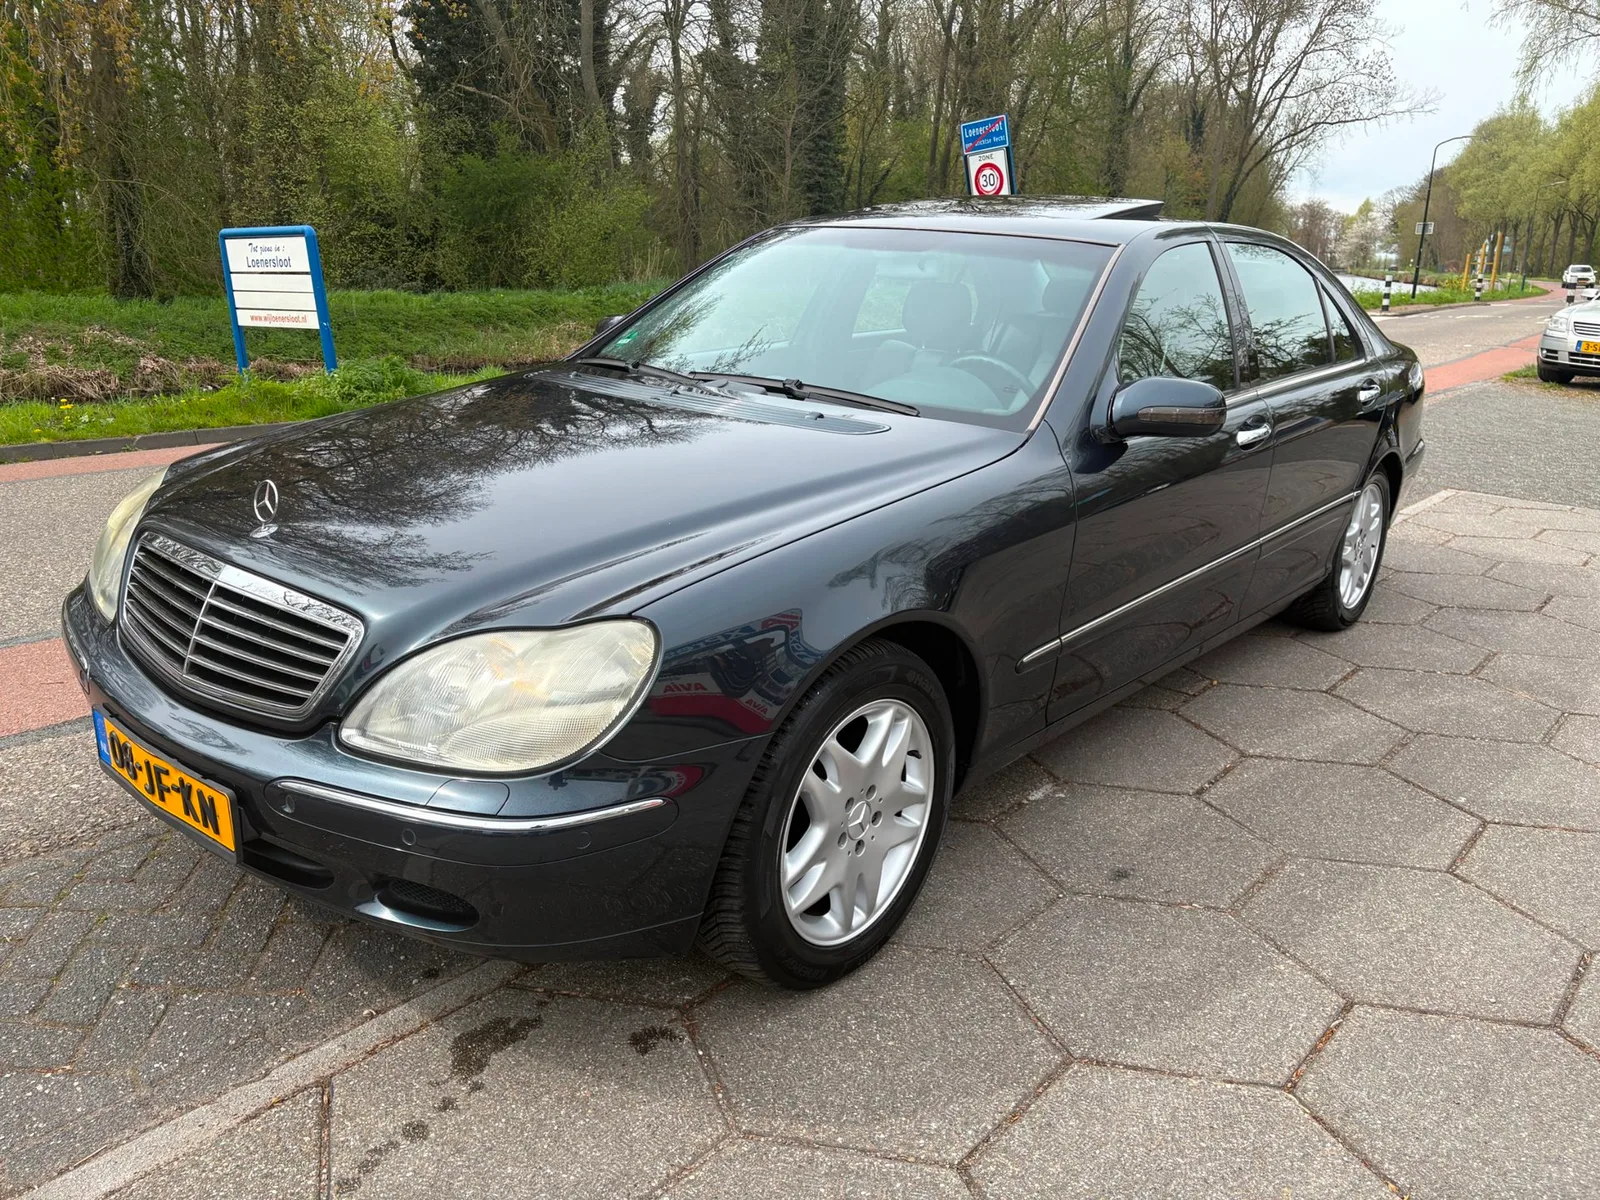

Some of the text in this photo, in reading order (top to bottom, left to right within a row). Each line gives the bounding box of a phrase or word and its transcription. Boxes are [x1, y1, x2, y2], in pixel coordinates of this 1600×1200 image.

[978, 153, 994, 162] ZONE
[981, 173, 996, 188] 30
[246, 256, 291, 268] Loenersloot
[109, 730, 220, 835] 08-JF-KN
